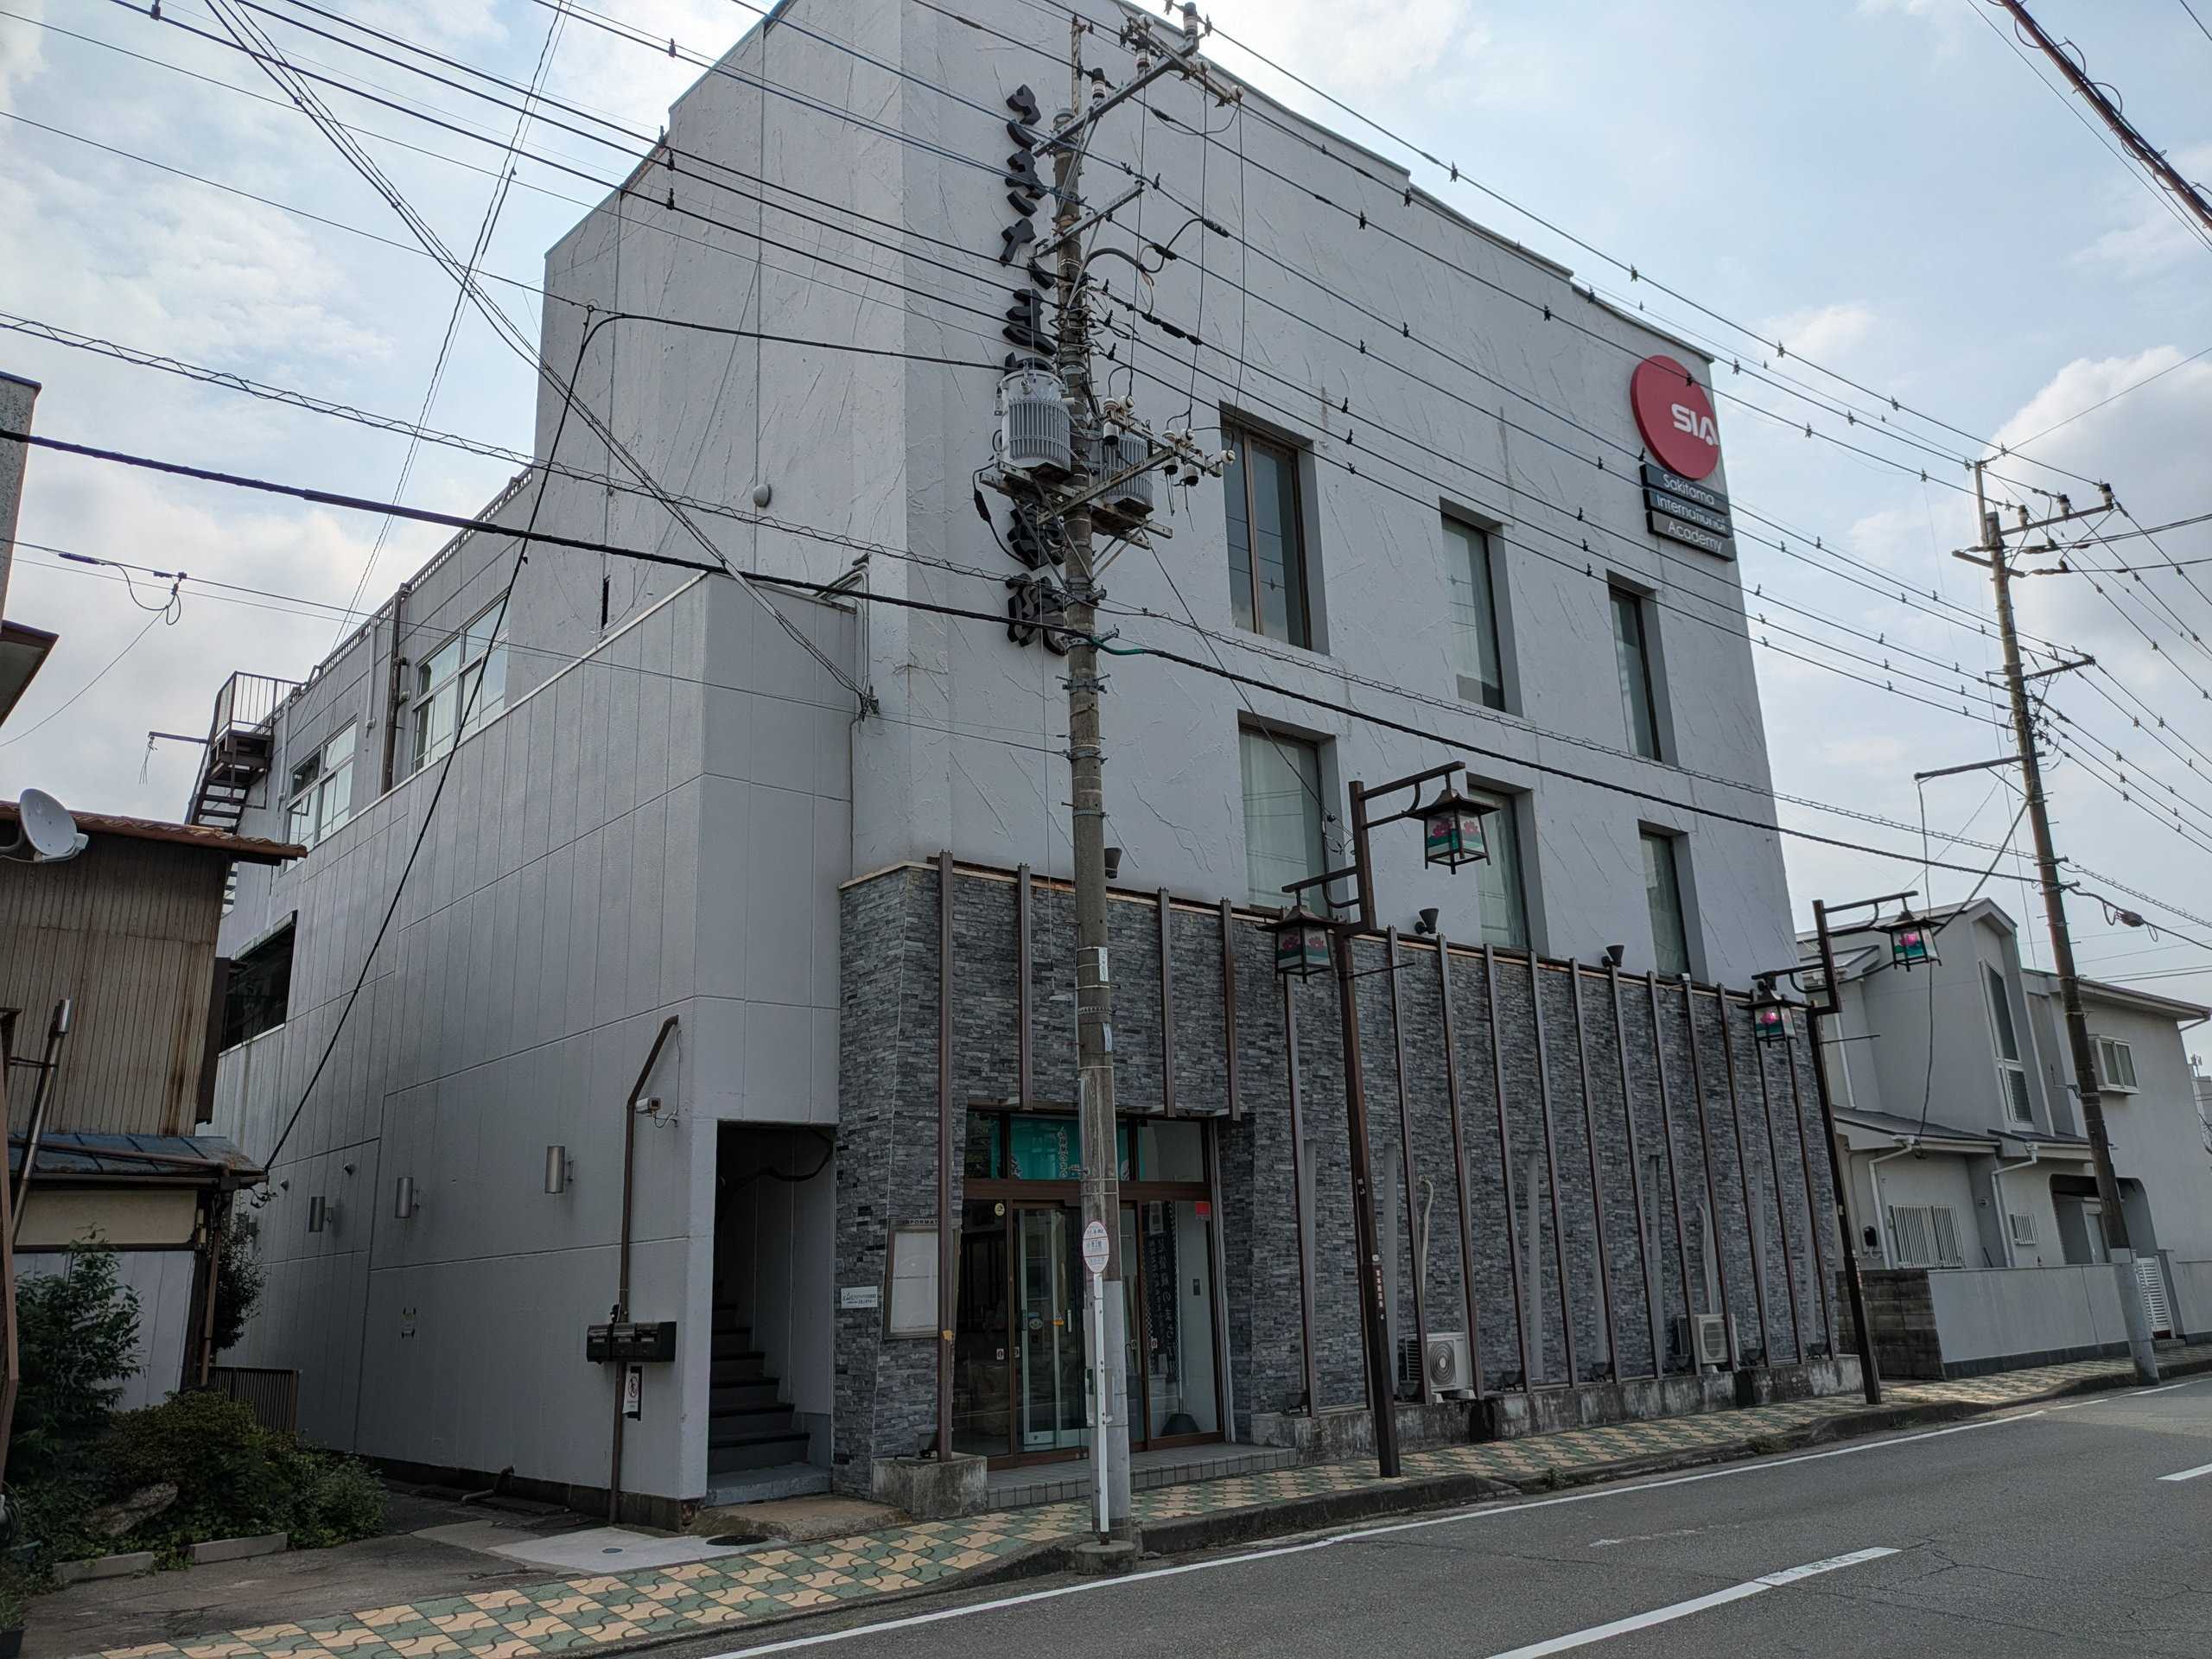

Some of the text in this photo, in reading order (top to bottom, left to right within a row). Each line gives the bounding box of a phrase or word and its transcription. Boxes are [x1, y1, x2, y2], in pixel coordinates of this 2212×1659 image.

[1671, 403, 1719, 446] SIA
[1662, 474, 1714, 505] Sakitama
[1668, 520, 1722, 554] Academy
